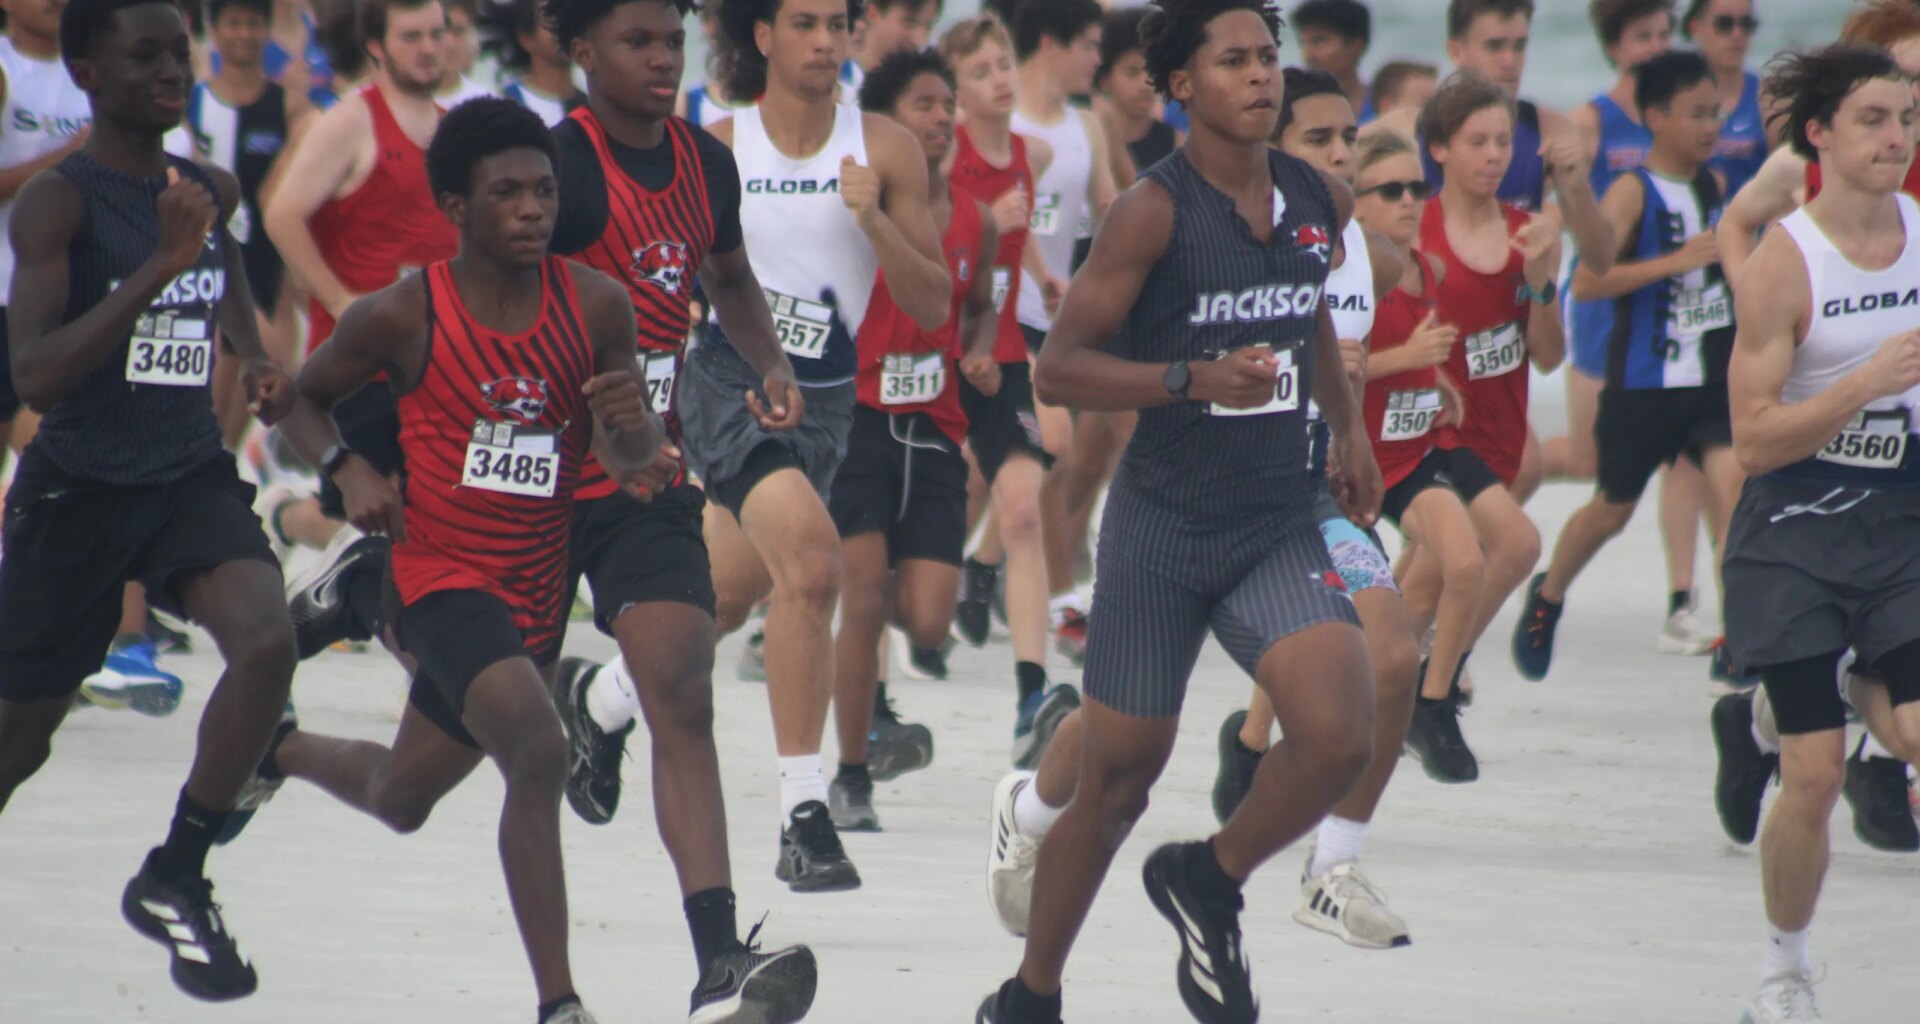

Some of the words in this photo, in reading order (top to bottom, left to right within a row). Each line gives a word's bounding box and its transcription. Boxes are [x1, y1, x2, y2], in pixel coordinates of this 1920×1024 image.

[746, 178, 839, 194] GLOBA
[1326, 294, 1368, 311] BAL
[1823, 288, 1918, 318] GLOBA
[775, 318, 825, 350] 557
[133, 342, 205, 375] 3480
[1472, 339, 1522, 375] 3507
[648, 376, 671, 404] 79
[886, 372, 938, 397] 3511
[1825, 432, 1900, 460] 3560
[470, 448, 552, 487] 3485
